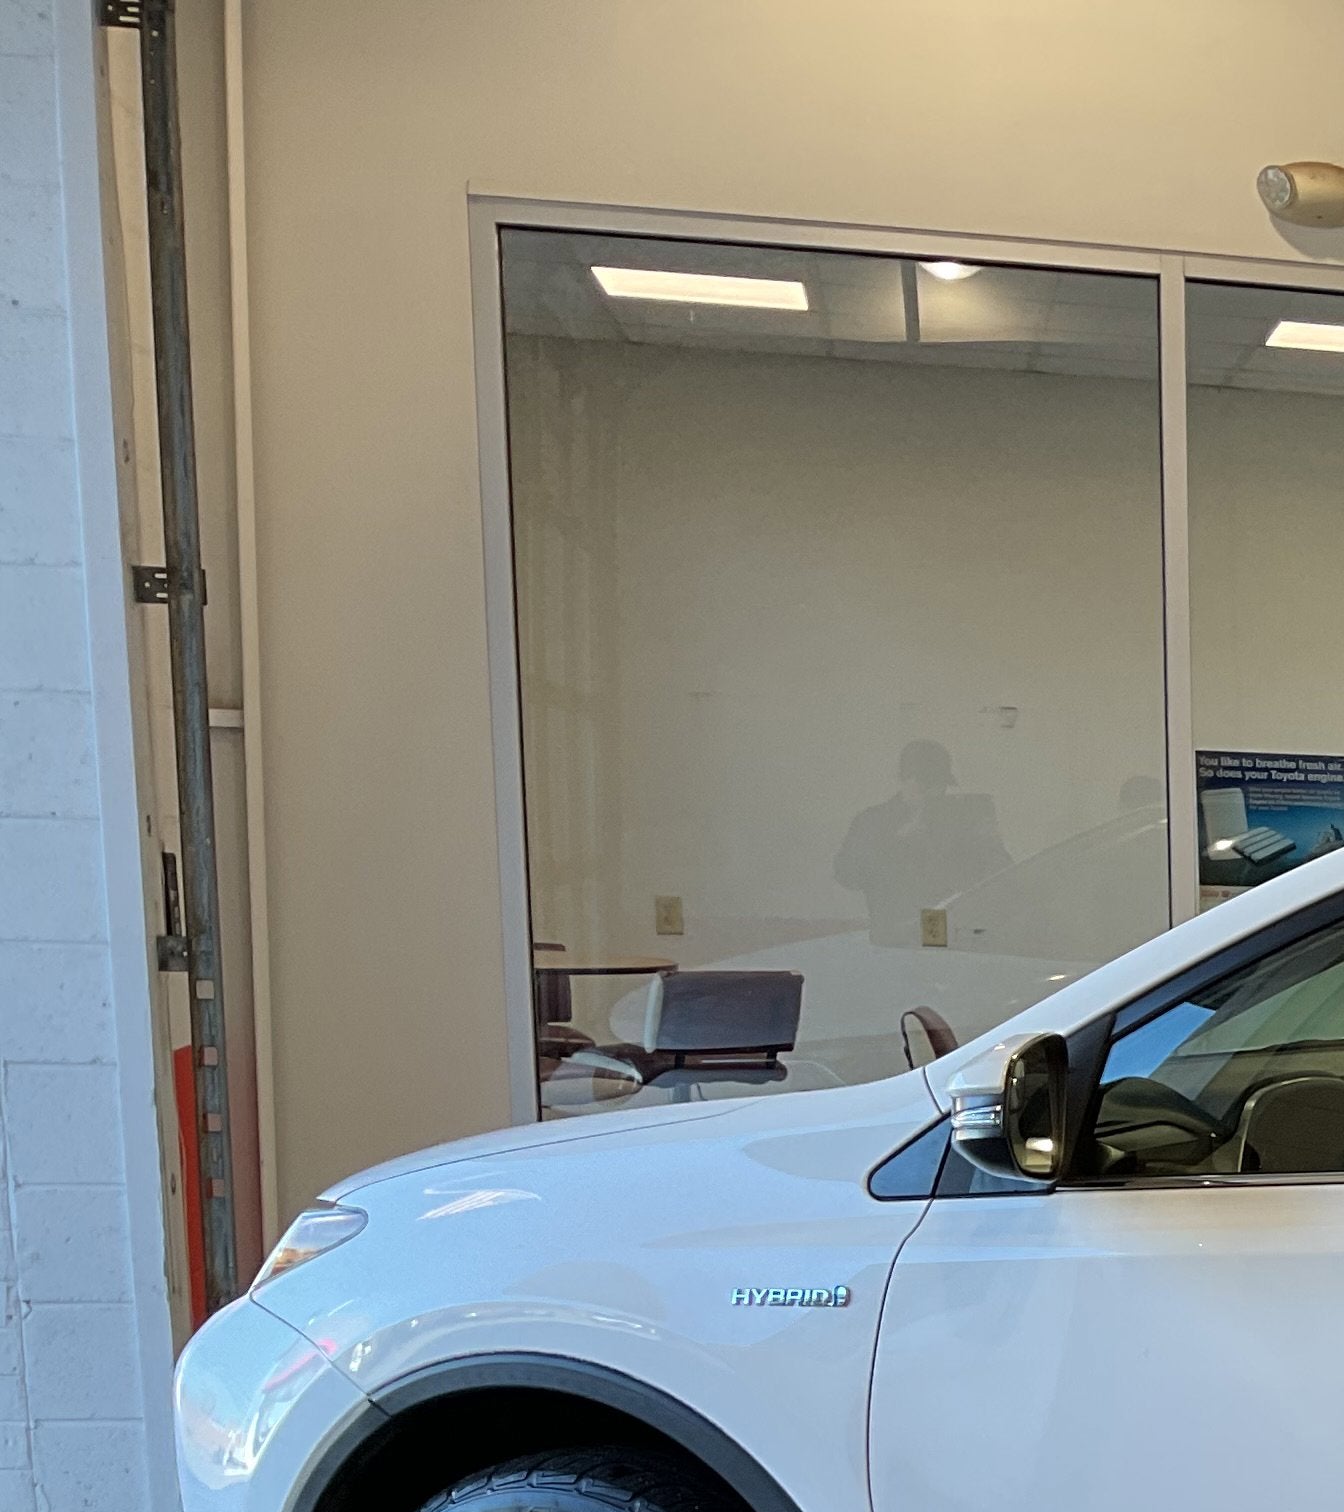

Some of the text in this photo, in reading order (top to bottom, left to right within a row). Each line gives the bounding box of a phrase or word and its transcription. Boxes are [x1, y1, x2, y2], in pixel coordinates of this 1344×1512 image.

[1220, 756, 1239, 767] like
[1242, 757, 1253, 767] to
[1255, 758, 1296, 769] breathe
[1199, 767, 1214, 777] So
[1245, 770, 1269, 781] your
[1270, 770, 1305, 782] Toyota
[731, 1287, 830, 1306] HYBRID
